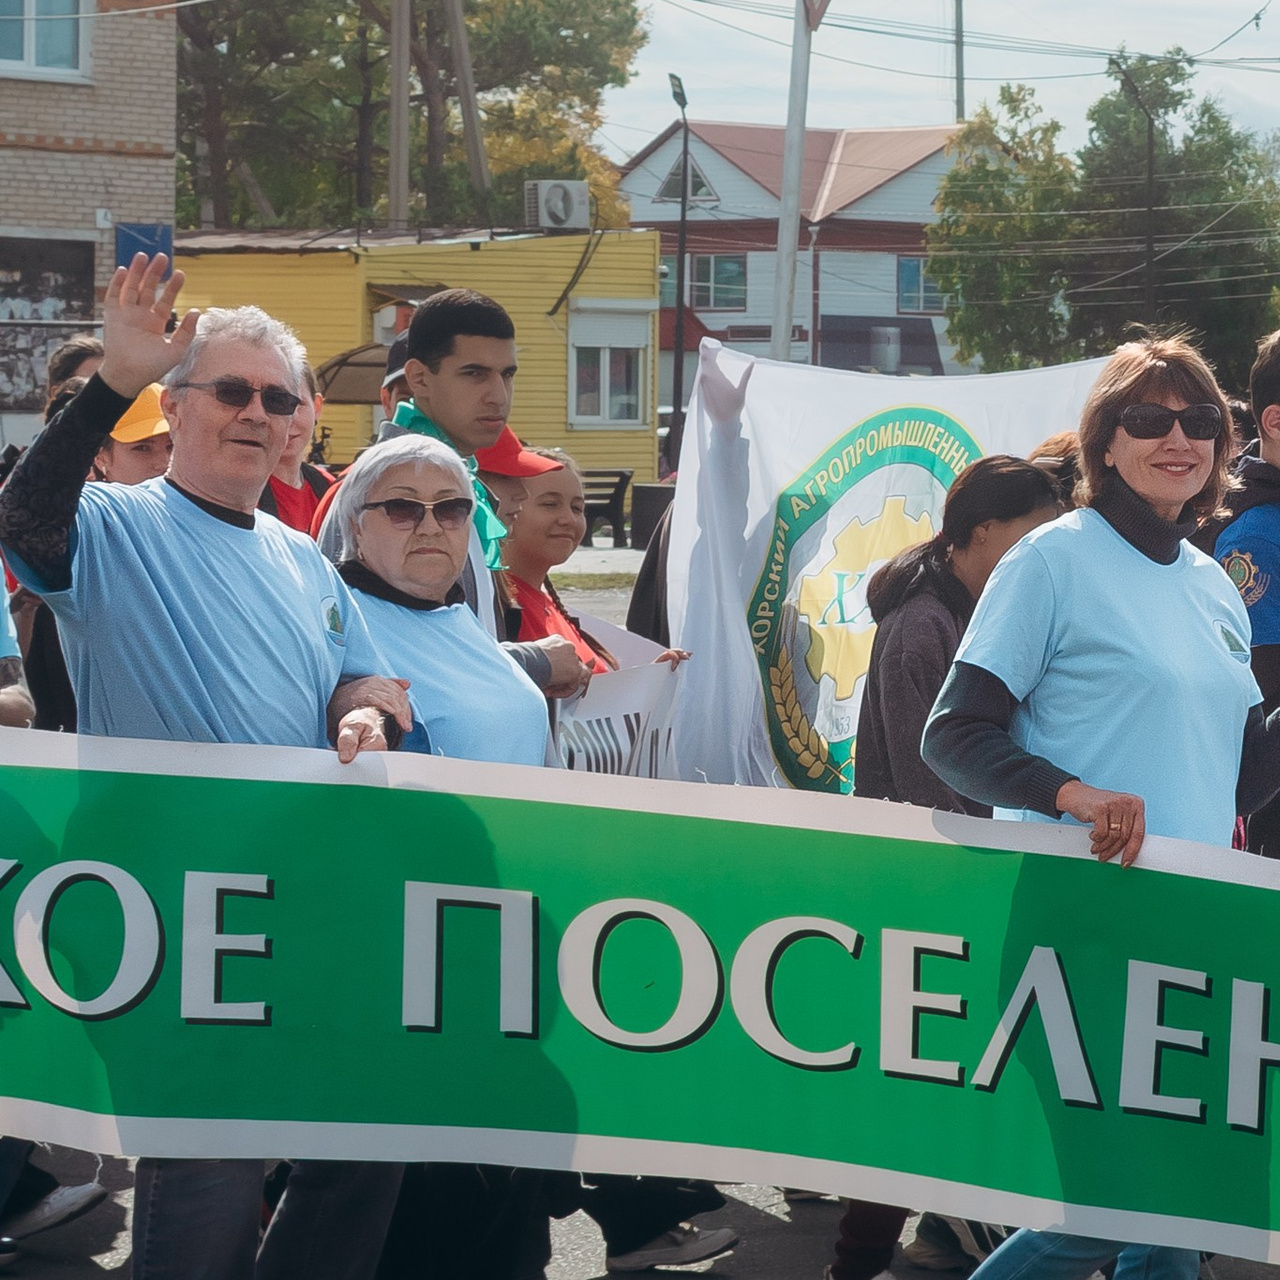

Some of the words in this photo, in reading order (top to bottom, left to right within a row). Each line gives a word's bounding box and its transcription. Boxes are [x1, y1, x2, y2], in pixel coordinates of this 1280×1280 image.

[753, 517, 790, 657] ХОРСКИЙ
[790, 420, 975, 519] АГРОПРОМЫШЛЕННЫ
[0, 858, 274, 1026] ОЕ
